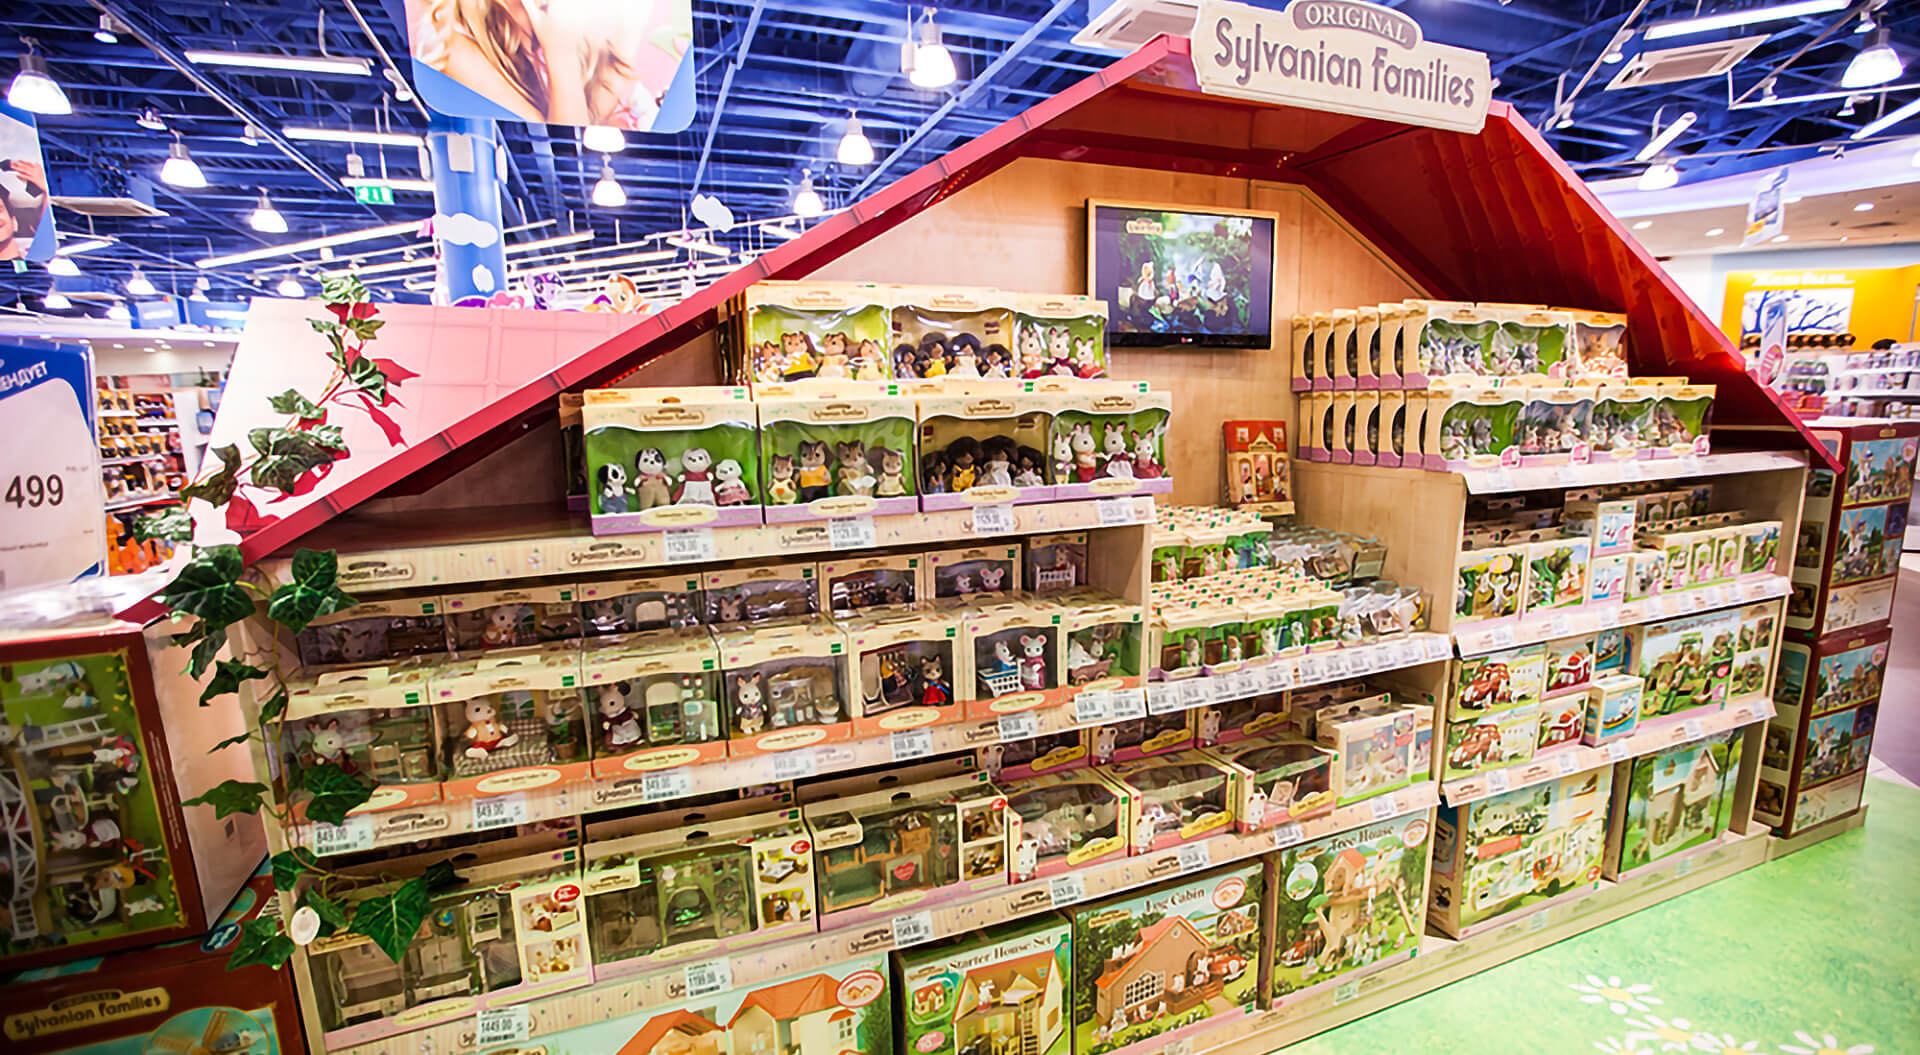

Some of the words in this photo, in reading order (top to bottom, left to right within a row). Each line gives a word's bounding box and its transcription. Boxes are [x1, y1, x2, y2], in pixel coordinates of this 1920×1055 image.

[1304, 5, 1409, 46] ORIGINAL
[1213, 16, 1362, 89] Sylvanian
[1371, 46, 1475, 109] Families
[5, 474, 64, 509] 499
[1170, 885, 1206, 907] Cabin
[993, 941, 1031, 960] House
[14, 1006, 95, 1036] Sylvanian
